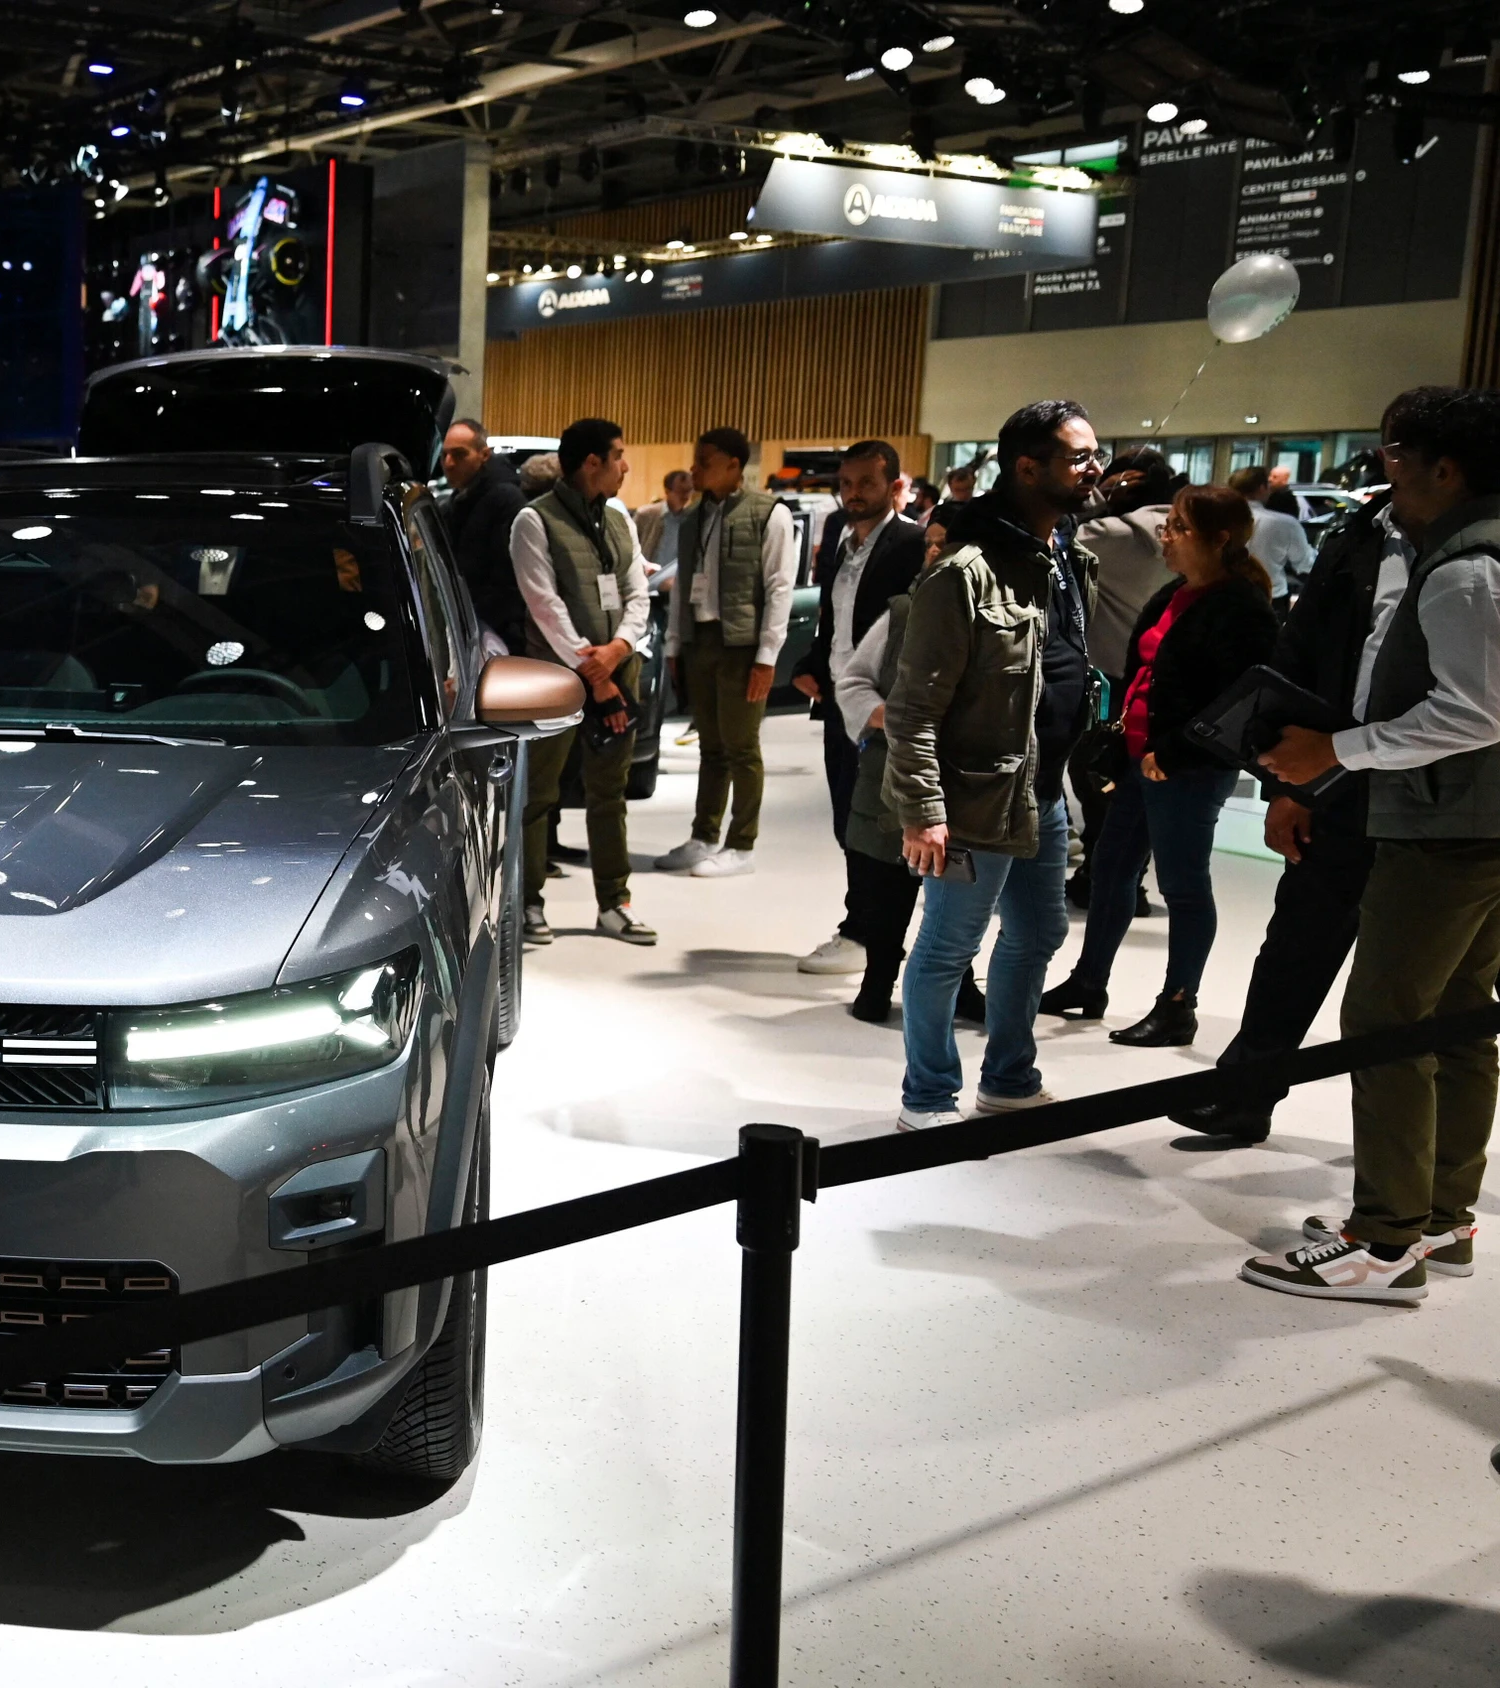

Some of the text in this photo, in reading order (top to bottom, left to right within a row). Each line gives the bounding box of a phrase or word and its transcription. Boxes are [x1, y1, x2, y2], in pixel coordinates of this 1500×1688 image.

[1140, 148, 1201, 166] SERELLE
[1241, 180, 1289, 196] CENTRE
[1239, 208, 1313, 225] ANIMATIONS
[1034, 282, 1085, 295] PAVILLON
